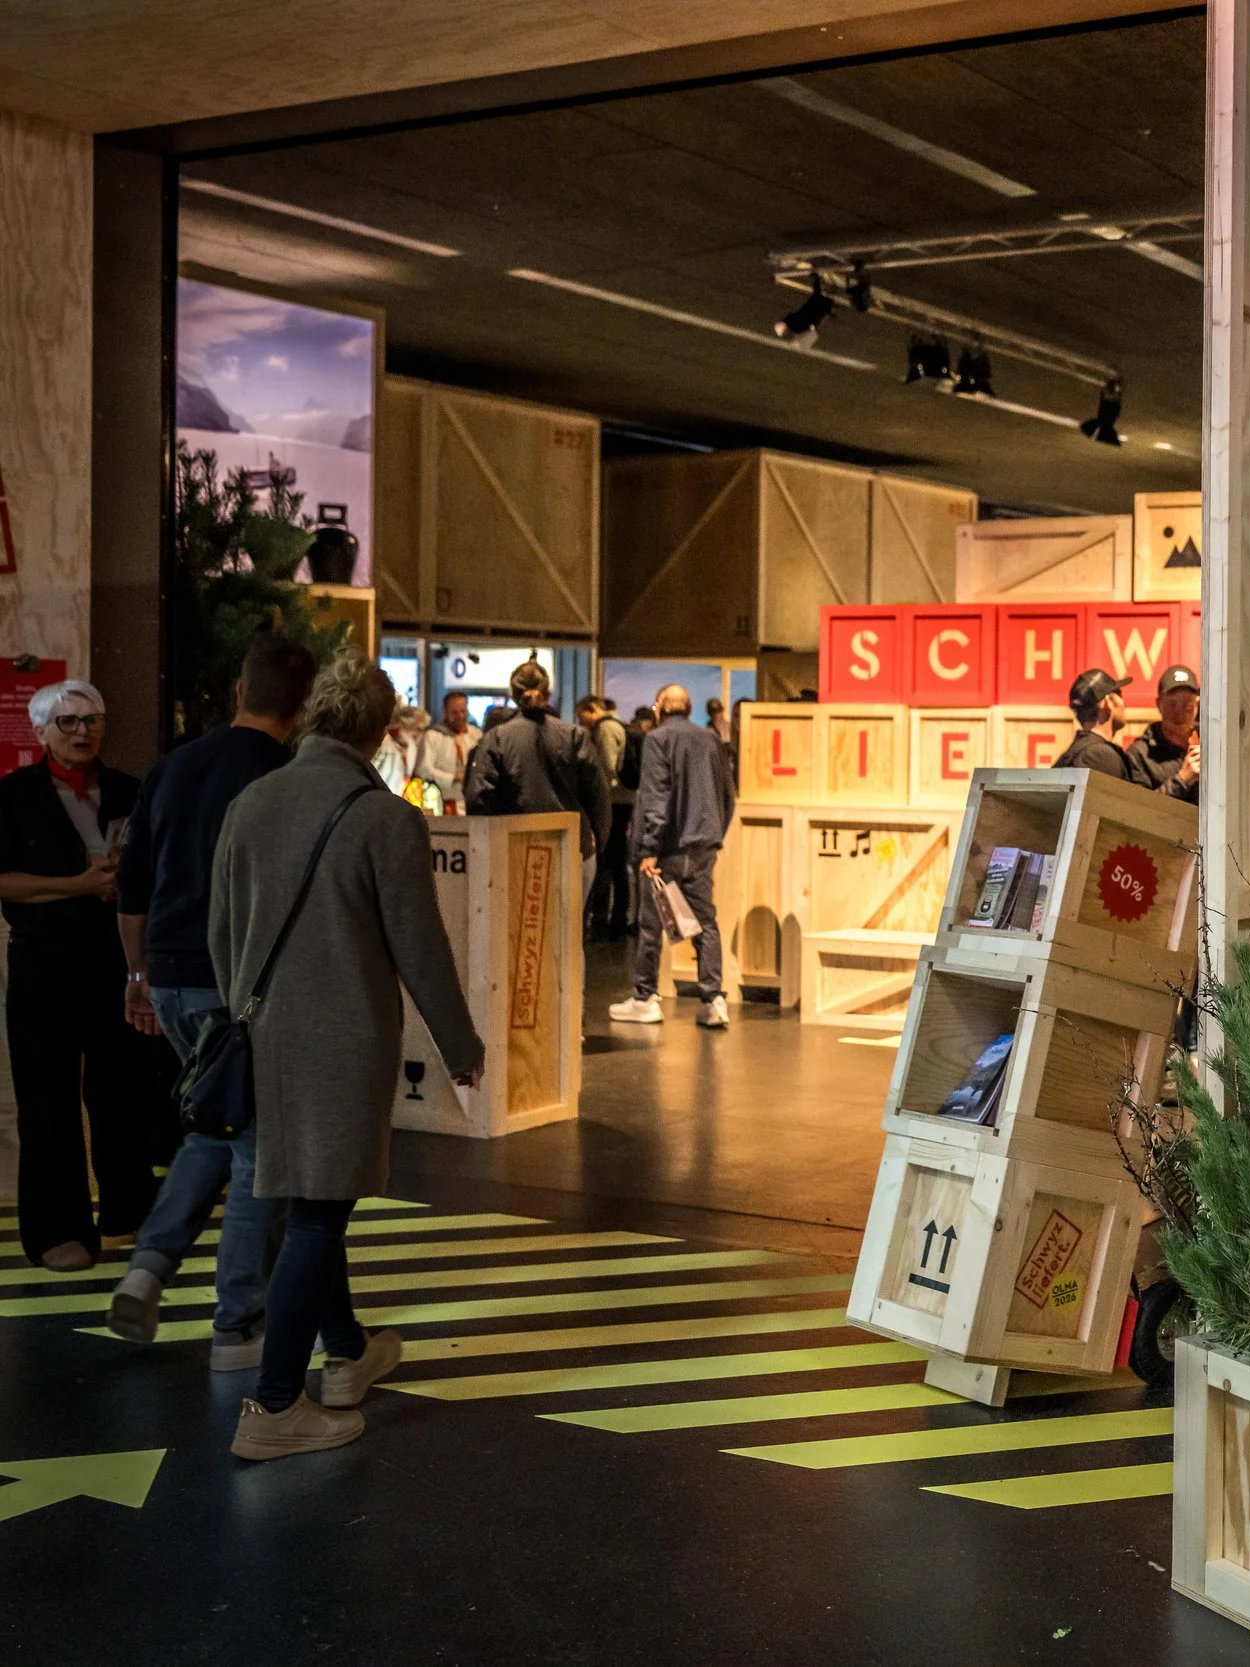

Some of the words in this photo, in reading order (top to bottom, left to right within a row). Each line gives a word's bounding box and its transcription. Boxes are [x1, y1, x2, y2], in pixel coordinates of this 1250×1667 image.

[850, 628, 1168, 681] SCHW
[772, 730, 1138, 779] LIEF
[1111, 864, 1145, 902] 50%
[518, 935, 538, 1021] Schwyz
[1022, 1222, 1063, 1289] Schwyz
[1032, 1242, 1071, 1299] liefert.
[1052, 1280, 1078, 1295] OLMA
[1054, 1292, 1077, 1307] 2026
